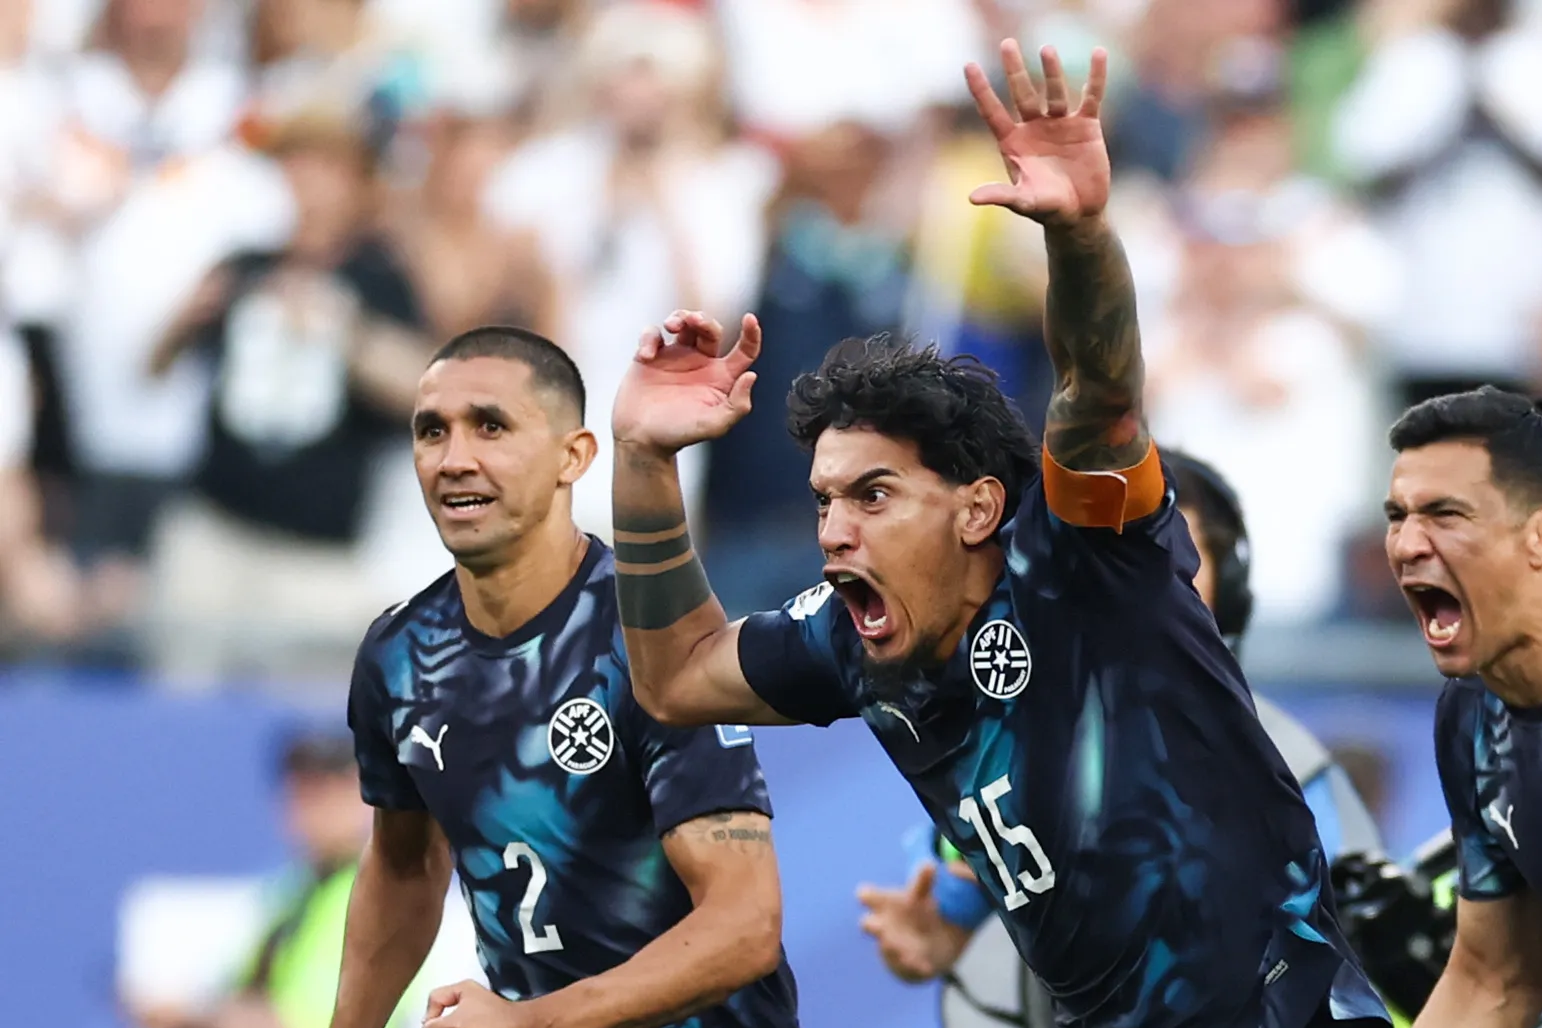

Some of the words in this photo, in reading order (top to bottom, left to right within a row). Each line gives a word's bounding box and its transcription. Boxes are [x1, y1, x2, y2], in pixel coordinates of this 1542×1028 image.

[979, 626, 997, 651] APF
[569, 704, 591, 720] APF
[958, 773, 1056, 912] 15
[502, 842, 564, 955] 2
